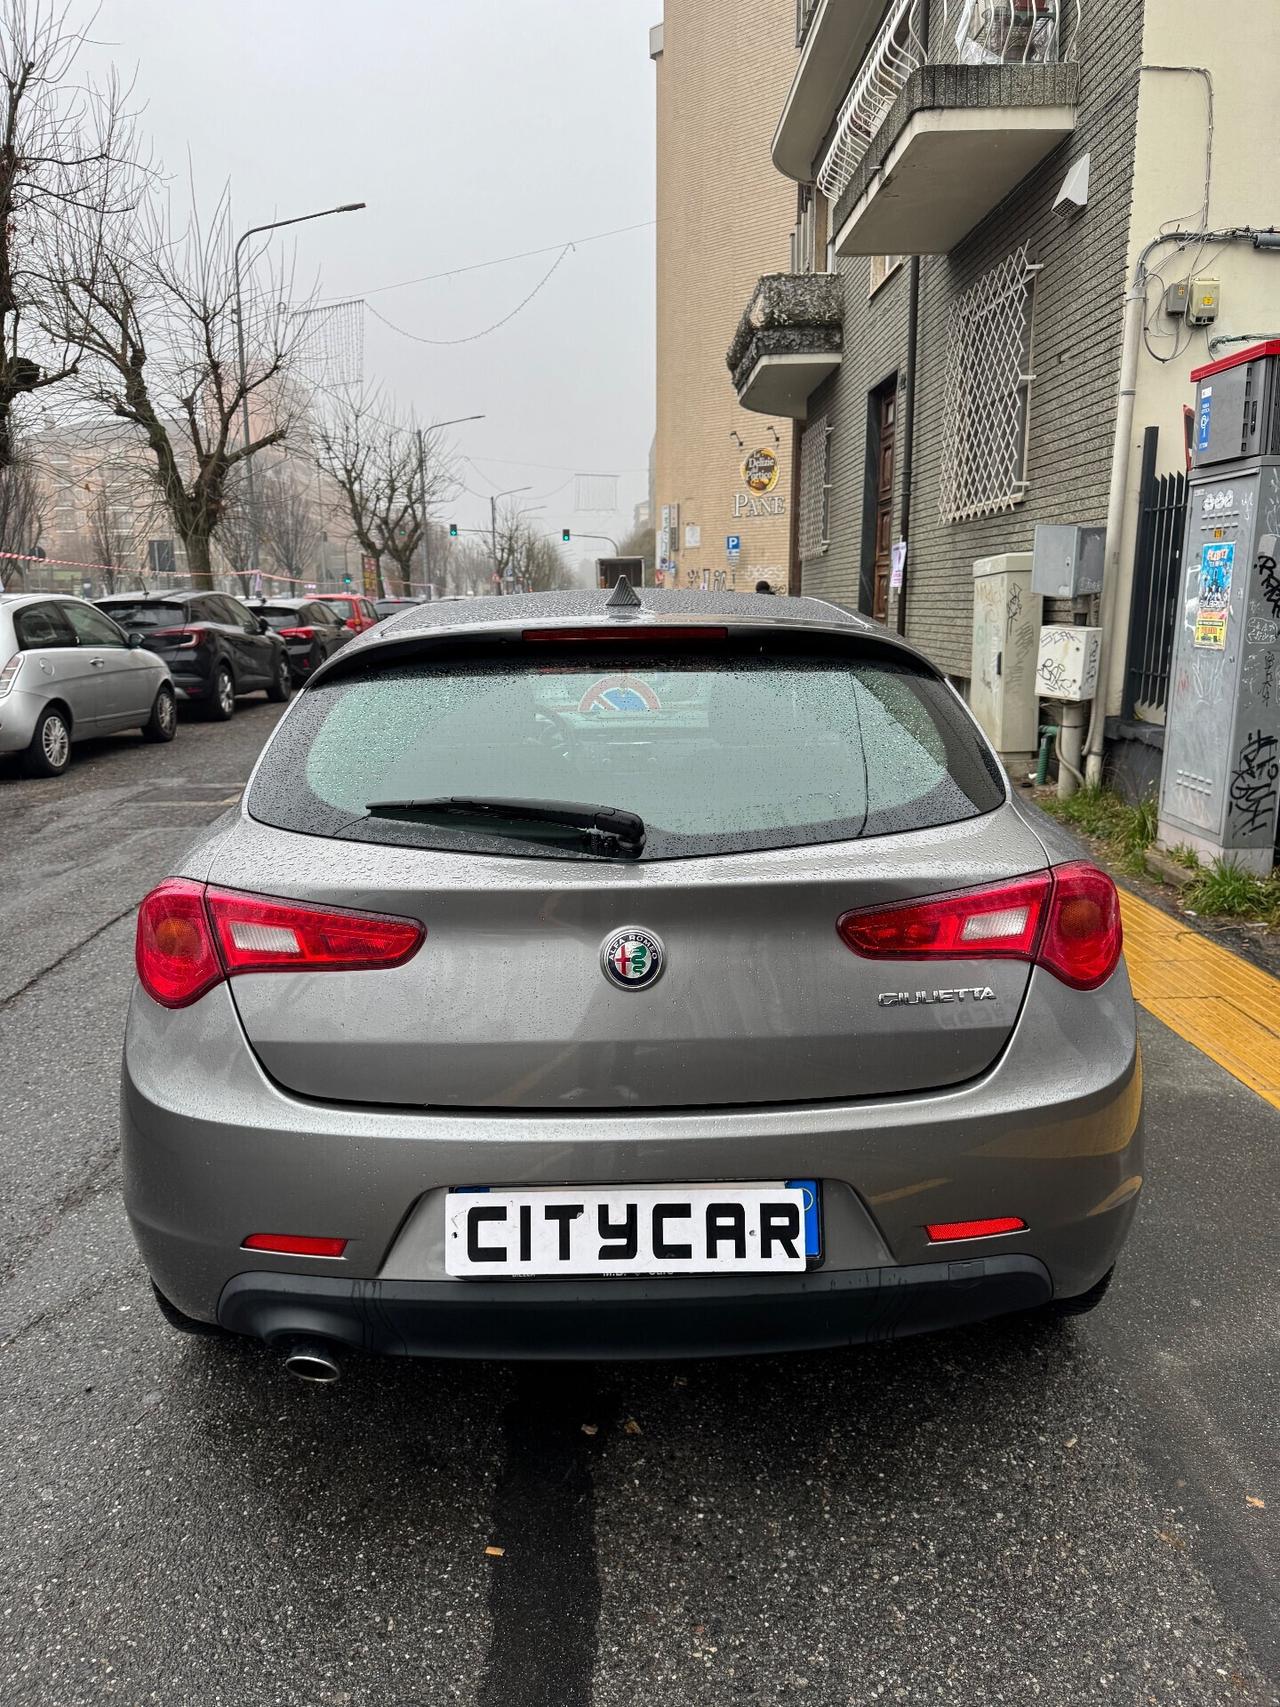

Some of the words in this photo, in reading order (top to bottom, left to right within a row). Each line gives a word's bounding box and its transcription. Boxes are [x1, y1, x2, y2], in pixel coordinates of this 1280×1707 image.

[733, 494, 785, 517] PANE
[729, 537, 738, 549] P
[609, 938, 625, 961] ALFA
[628, 934, 658, 960] ROMEO
[878, 986, 997, 1007] GIULIETTA
[467, 1202, 801, 1263] CITYCAR
